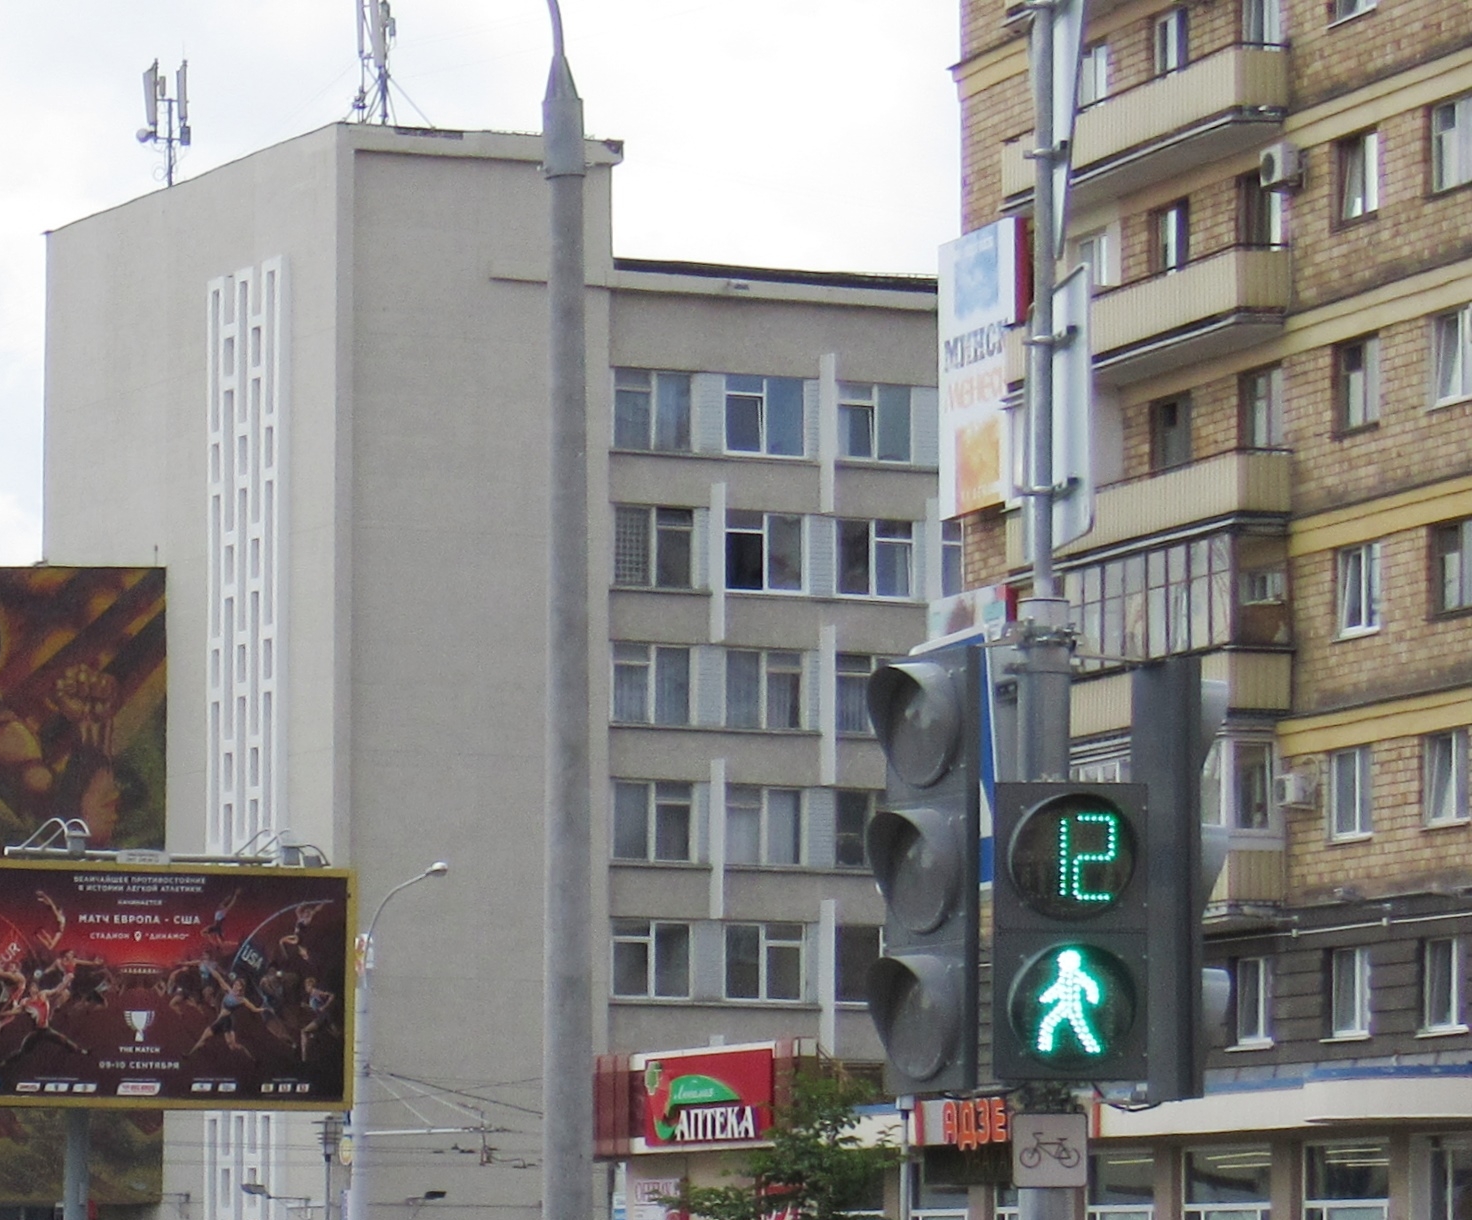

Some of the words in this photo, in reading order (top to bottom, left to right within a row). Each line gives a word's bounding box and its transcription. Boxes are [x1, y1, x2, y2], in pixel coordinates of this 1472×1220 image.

[1058, 812, 1117, 903] 12
[79, 915, 110, 923] МАТЧ
[114, 915, 160, 924] ЕВРОПА
[174, 916, 201, 924] США
[241, 944, 263, 970] USA
[675, 1106, 755, 1141] АПТЕКА
[942, 1097, 1012, 1151] АДЗЕ
